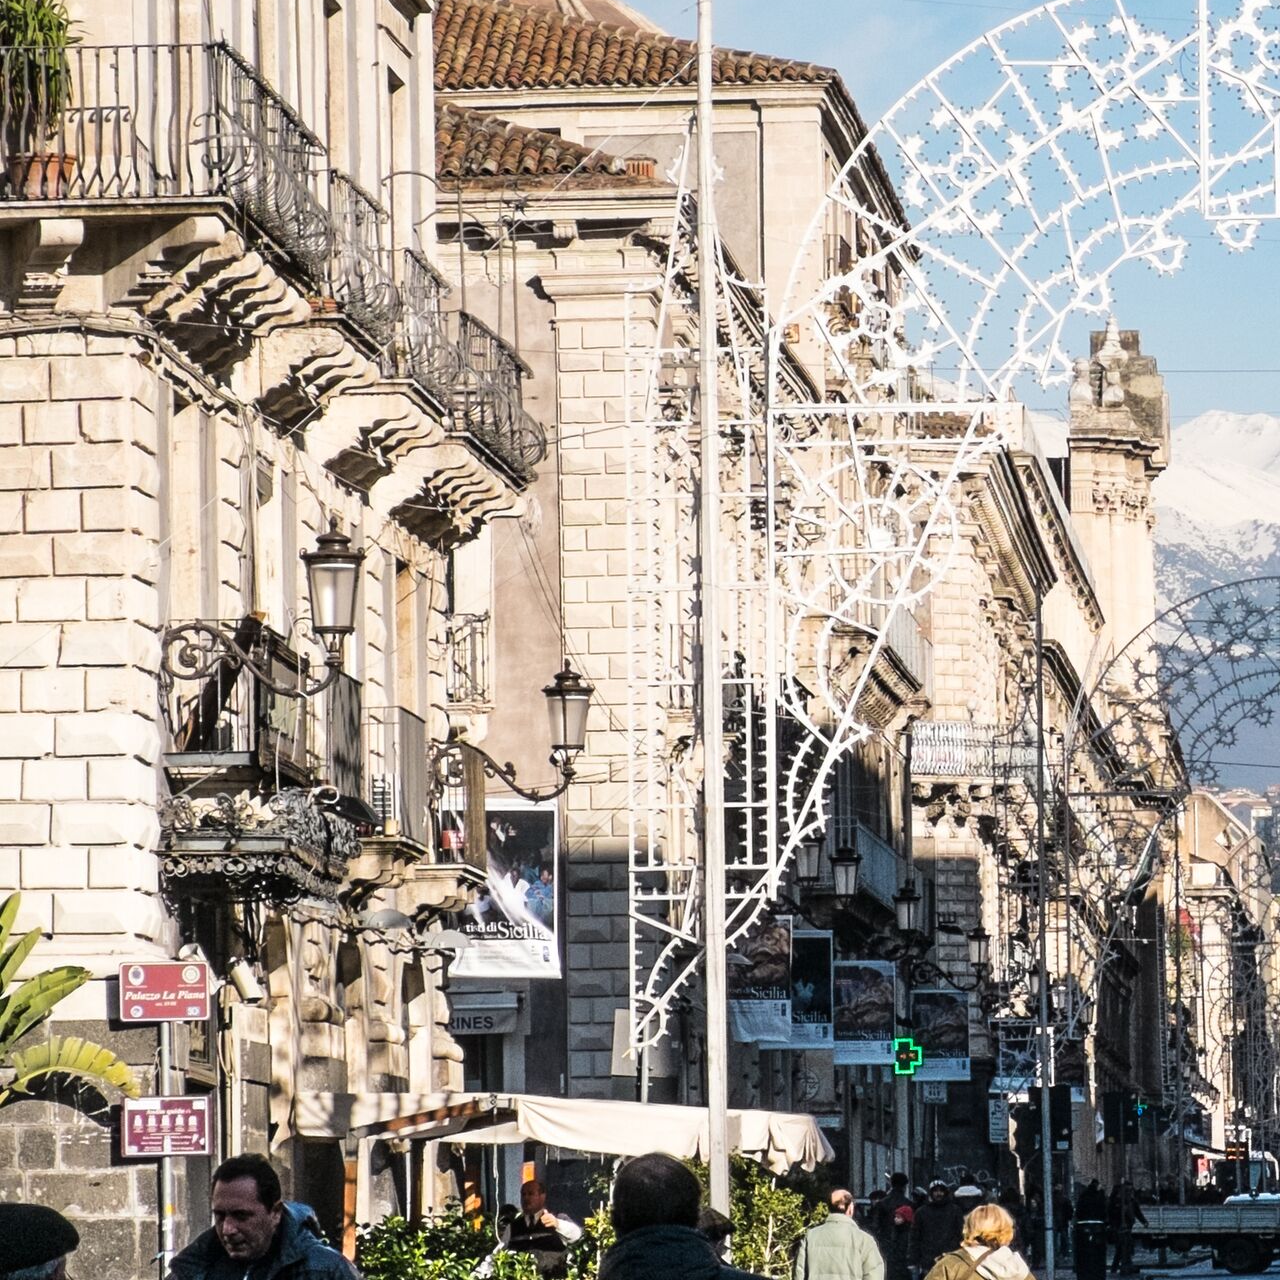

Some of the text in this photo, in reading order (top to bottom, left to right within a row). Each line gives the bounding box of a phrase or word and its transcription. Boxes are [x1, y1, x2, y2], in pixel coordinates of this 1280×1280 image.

[497, 921, 549, 939] Sicilia
[125, 990, 205, 1001] Palazzo La Piana
[751, 986, 787, 999] Sicilia
[792, 1010, 828, 1023] Sicilia
[861, 1029, 892, 1039] Sicilia
